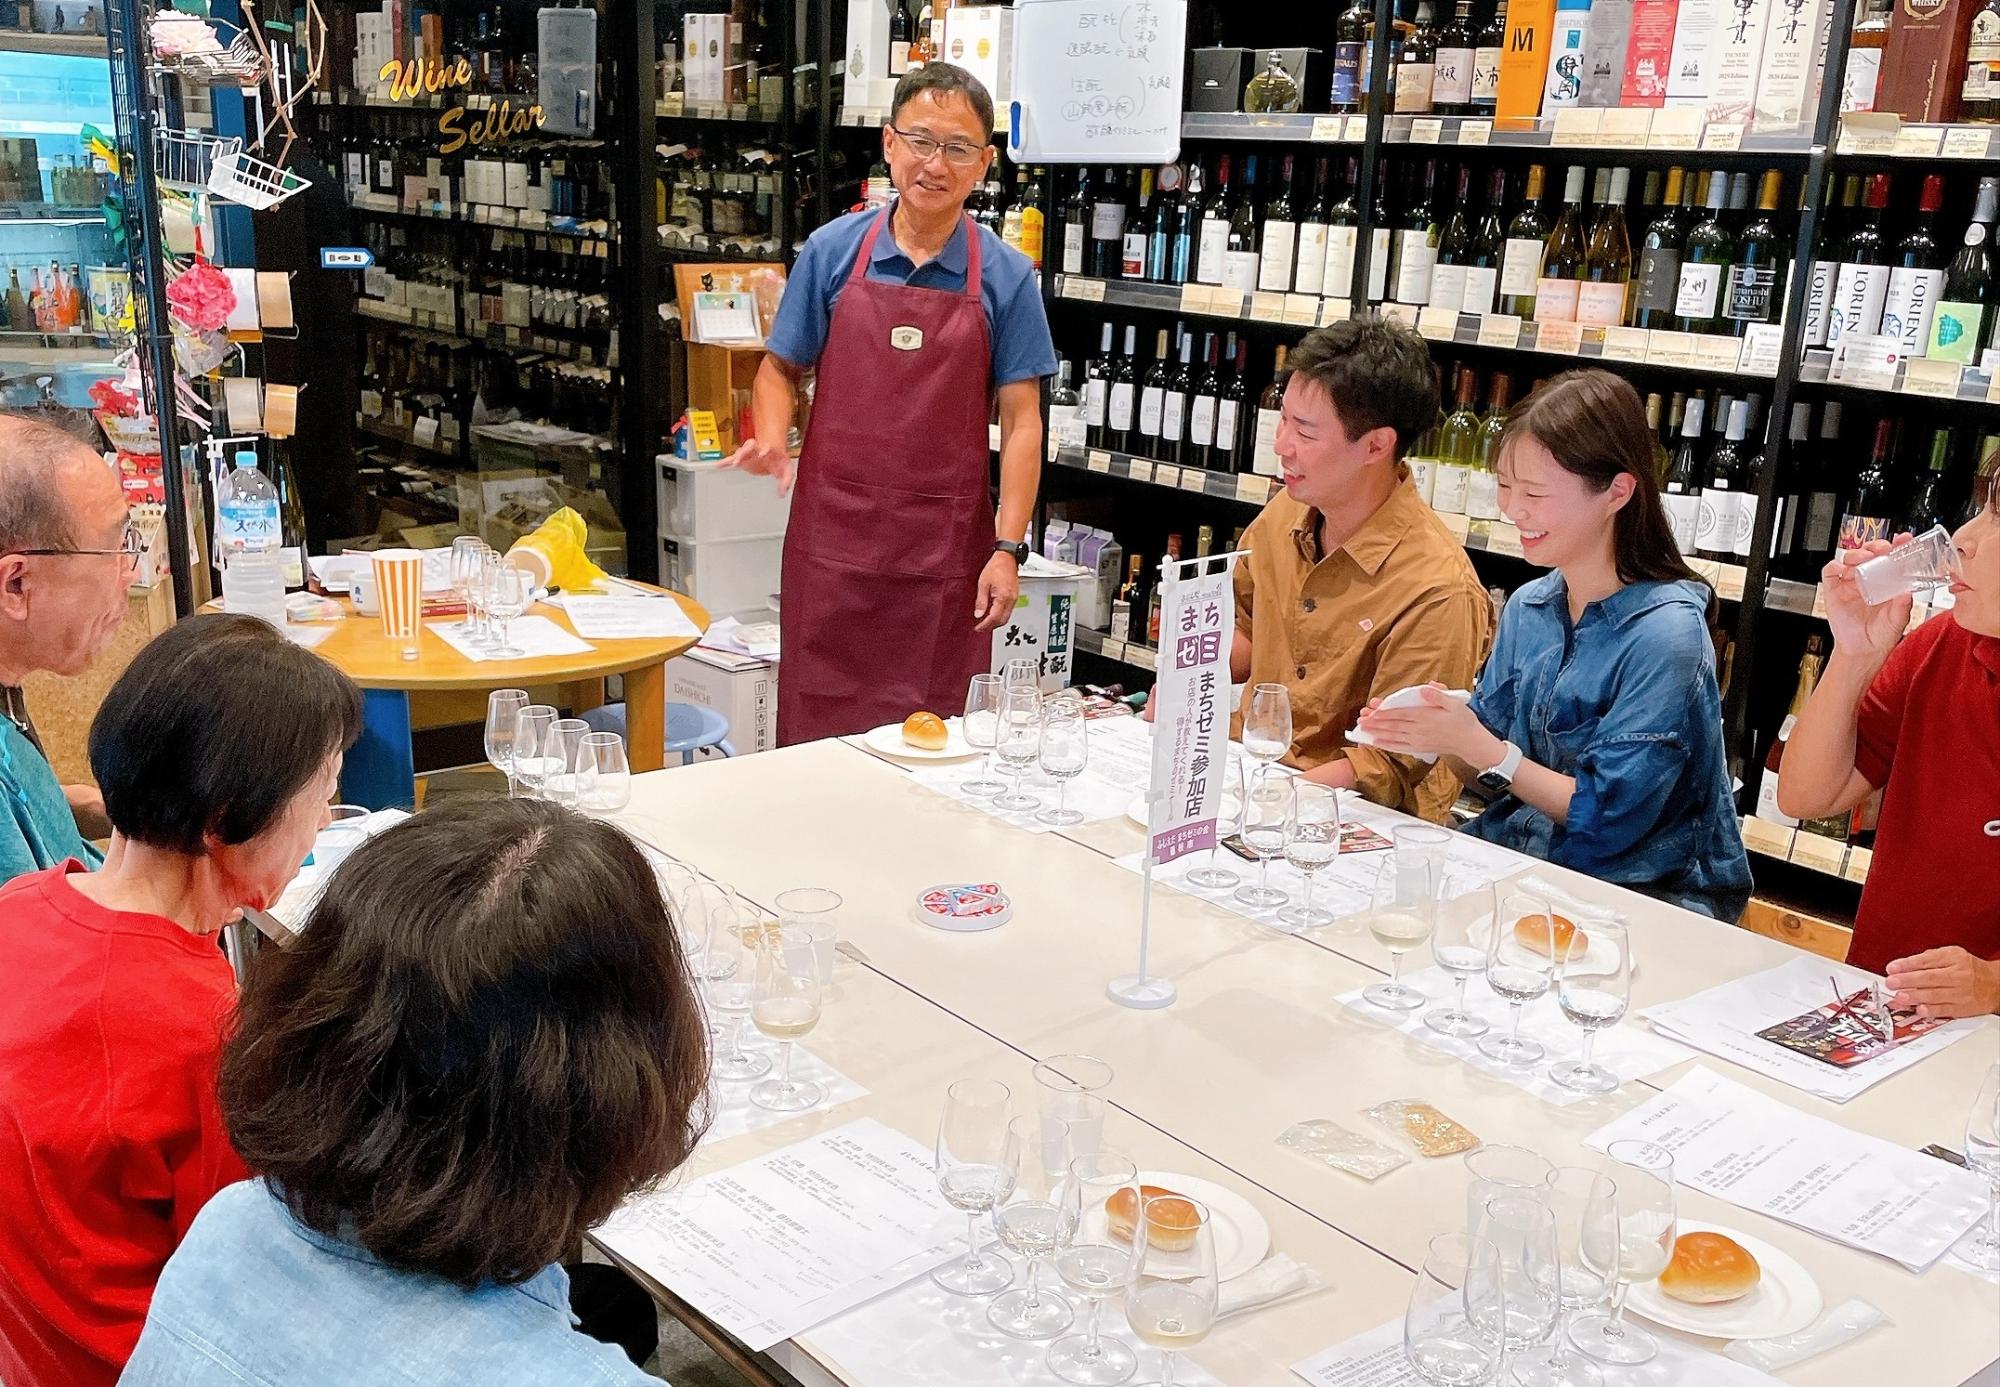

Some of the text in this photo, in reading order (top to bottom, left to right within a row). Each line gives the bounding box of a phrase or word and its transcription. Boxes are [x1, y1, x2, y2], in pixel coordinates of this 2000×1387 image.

[378, 57, 472, 102] Wine
[439, 99, 547, 154] Sellar
[1807, 267, 1827, 339] L'ORIENT
[1846, 270, 1869, 334] L'ORIEN
[1903, 275, 1928, 351] L'ORIENT
[1181, 601, 1220, 632] まち
[1177, 635, 1218, 666] ゼミ
[1184, 670, 1215, 819] まちゼミ参加店
